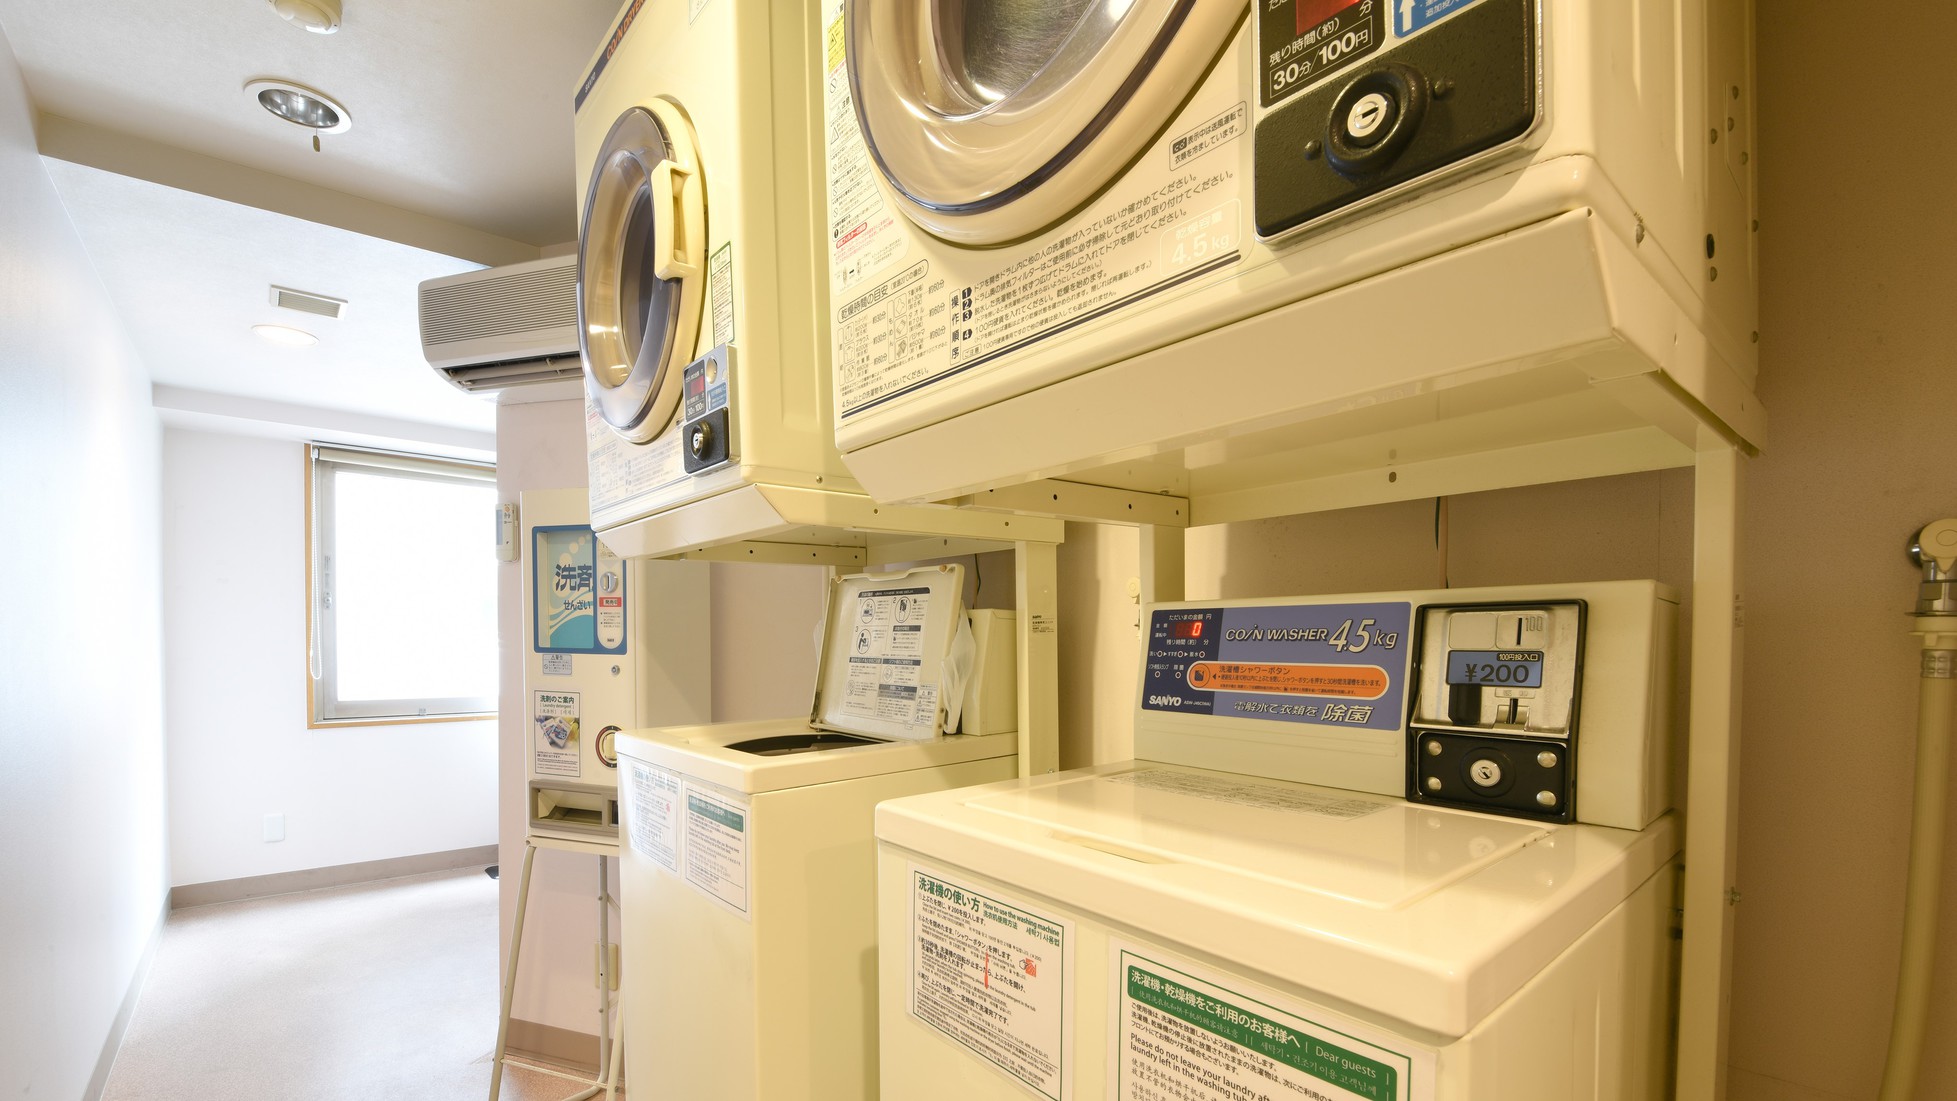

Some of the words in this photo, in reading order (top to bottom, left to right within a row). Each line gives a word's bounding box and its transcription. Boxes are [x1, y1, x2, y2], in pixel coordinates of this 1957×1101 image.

[1272, 28, 1369, 91] 30分/100円
[1171, 231, 1208, 265] 4.5
[1211, 233, 1230, 250] kg
[564, 600, 591, 611] せんざい
[1192, 622, 1202, 637] 0
[1267, 628, 1328, 641] WASHER
[1499, 653, 1539, 661] 100円投入口
[1464, 663, 1530, 684] ¥200
[1149, 694, 1182, 707] SANYO
[1321, 703, 1374, 724] 除菌
[918, 876, 981, 913] 洗濯機の使い方
[1131, 969, 1300, 1048] 洗濯機・乾燥機をご利用のお客様へ
[1315, 1045, 1339, 1064] Dear
[1341, 1058, 1377, 1079] guests
[1130, 1033, 1153, 1050] Please
[1154, 1044, 1165, 1055] do
[1166, 1050, 1178, 1063] not
[1180, 1056, 1201, 1073] leave
[1202, 1067, 1221, 1082] your
[1223, 1076, 1256, 1100] laundry
[1130, 1041, 1158, 1063] laundry
[1159, 1056, 1172, 1069] left
[1173, 1063, 1181, 1073] in
[1182, 1066, 1195, 1080] the
[1196, 1075, 1231, 1099] washing
